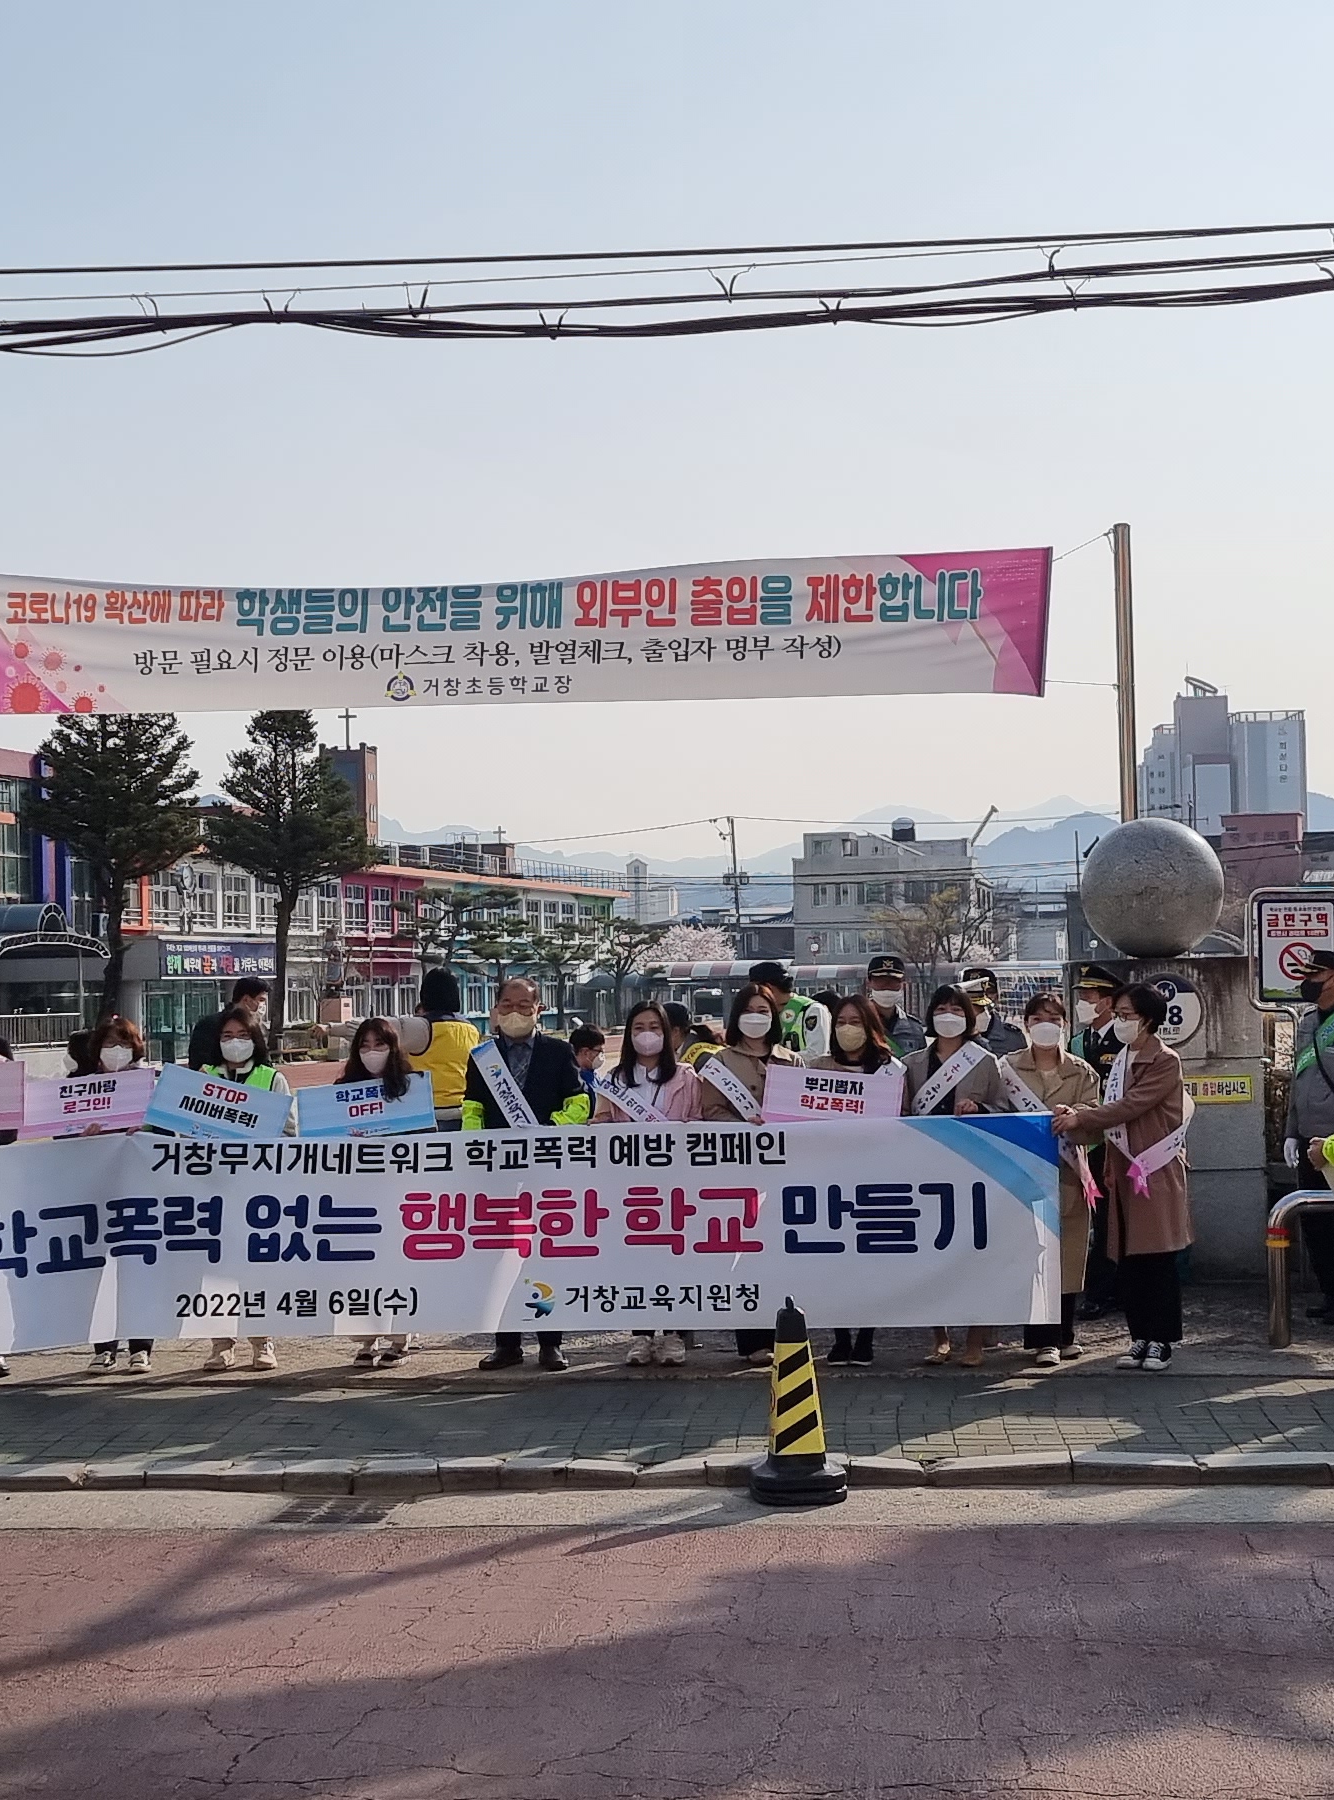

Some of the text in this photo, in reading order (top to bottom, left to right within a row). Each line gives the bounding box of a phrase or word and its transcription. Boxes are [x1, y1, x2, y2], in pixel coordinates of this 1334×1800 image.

[5, 590, 97, 626] 코로나19
[104, 589, 172, 625] 확산에
[178, 589, 225, 623] 따라
[235, 586, 369, 636] 학생들의
[382, 584, 481, 634] 안전을
[495, 580, 563, 631] 위해
[574, 576, 677, 628] 외부인
[690, 574, 793, 627] 출입을
[804, 568, 984, 625] 제한합니다
[133, 632, 843, 676] 방문 필요시 정문 이용(마스크 착용, 발열체크, 출입자 명부 작성)
[421, 673, 573, 698] 거창초등학교장
[1266, 912, 1328, 928] 금연구역
[58, 1079, 118, 1099] 친구사랑
[202, 1082, 248, 1105] STOP
[335, 1085, 386, 1103] 학교폭
[804, 1075, 865, 1096] 뿌리뽑자
[61, 1096, 111, 1114] 로그인!
[178, 1095, 259, 1130] 사이버폭력!
[349, 1101, 384, 1118] OFF!
[800, 1093, 865, 1115] 학교폭력!
[151, 1130, 788, 1176] 거창무지개네트워크 학교폭력 예방 캠페인
[243, 1194, 382, 1266] 없는
[400, 1186, 610, 1262] 행복한
[622, 1184, 764, 1262] 학교
[780, 1180, 989, 1255] 만들기
[175, 1286, 419, 1320] 2022년 4월 6일(수)
[563, 1282, 761, 1315] 거창교육지원청
